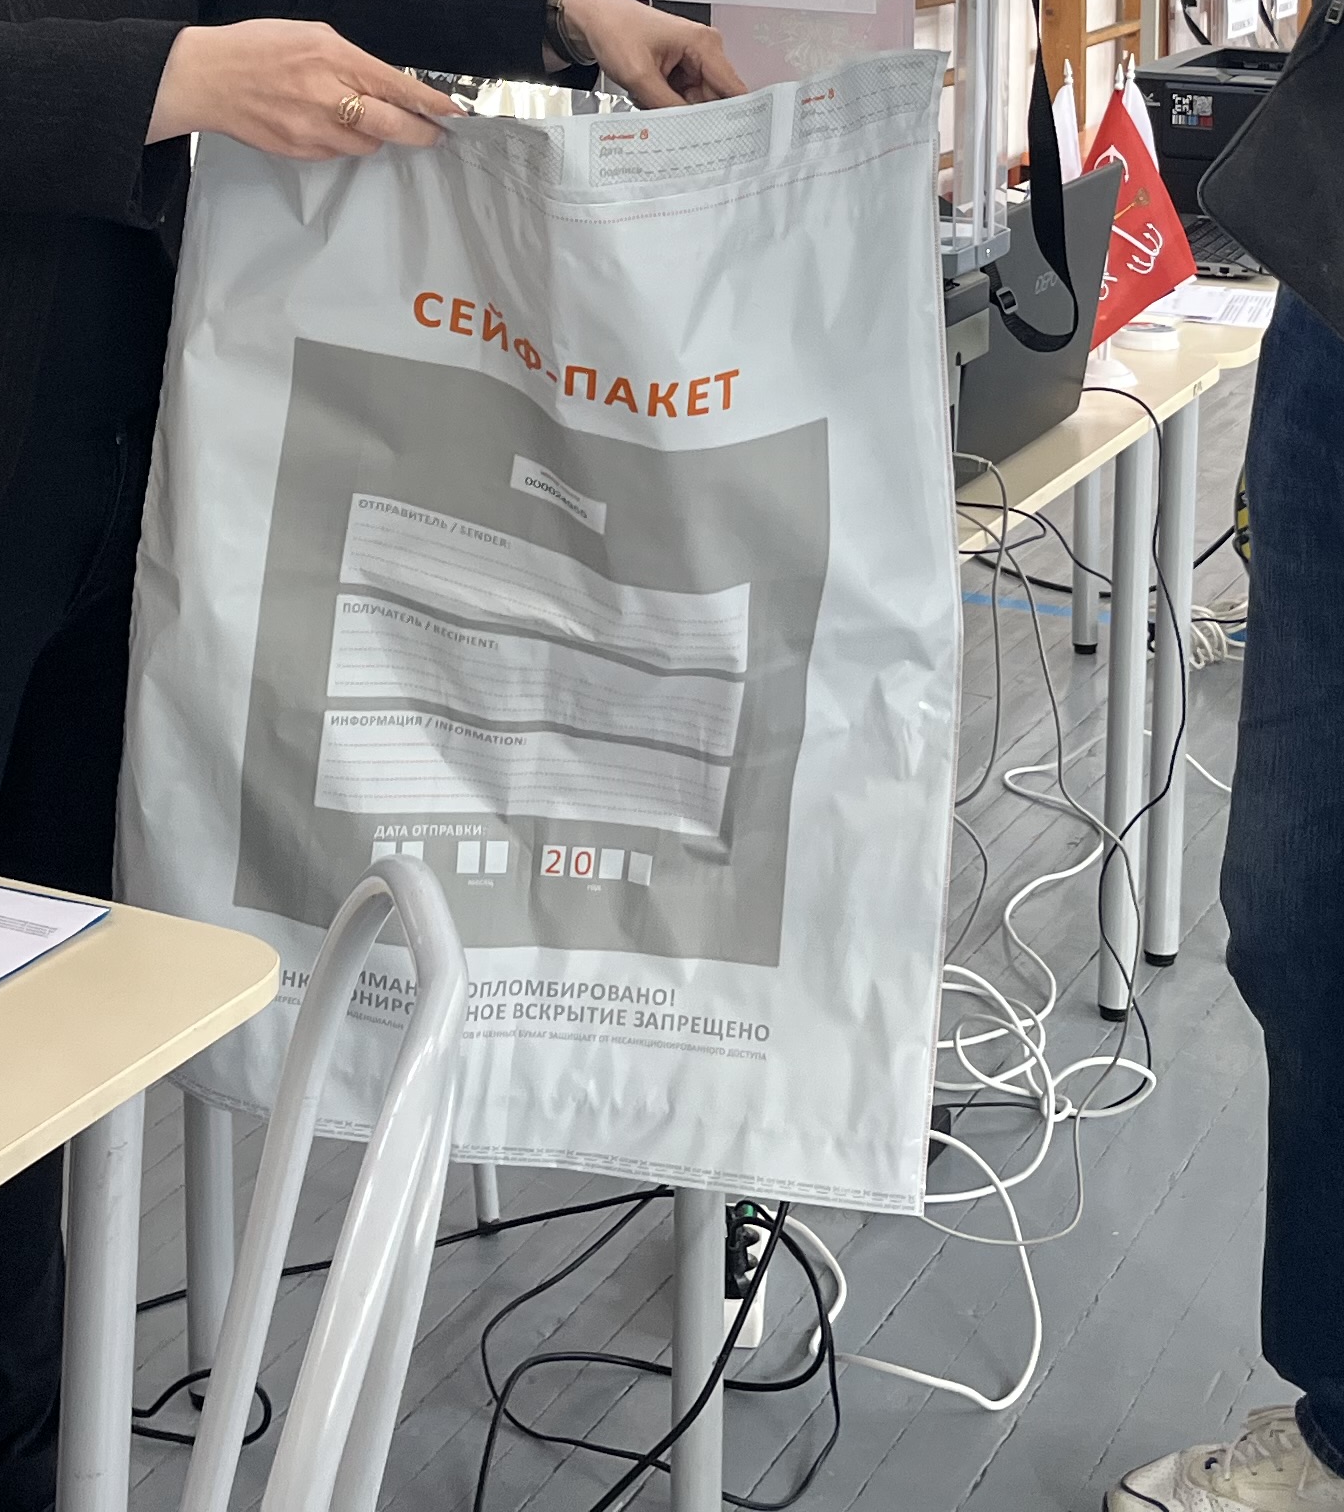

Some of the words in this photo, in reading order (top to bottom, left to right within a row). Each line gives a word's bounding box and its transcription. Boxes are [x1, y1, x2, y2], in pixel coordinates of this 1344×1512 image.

[599, 145, 624, 158] Дата
[413, 291, 740, 418] СЕЙФ-ПАКЕТ
[358, 498, 448, 531] ОТПРАВИТЕЛЬ
[459, 525, 511, 550] SENDER:
[342, 602, 423, 628] ПОЛУЧАТЕЛЬ
[433, 624, 499, 651] RECIPIENT:
[330, 715, 423, 728] ИНФОРМАЦИЯ
[434, 719, 527, 746] INFORMATION:
[374, 825, 409, 839] ДАТА
[412, 823, 487, 837] ОТПРАВКИ:
[513, 1003, 627, 1027] ВСКРЫТИЕ
[633, 1010, 770, 1042] ЗАПРЕЩЕНО
